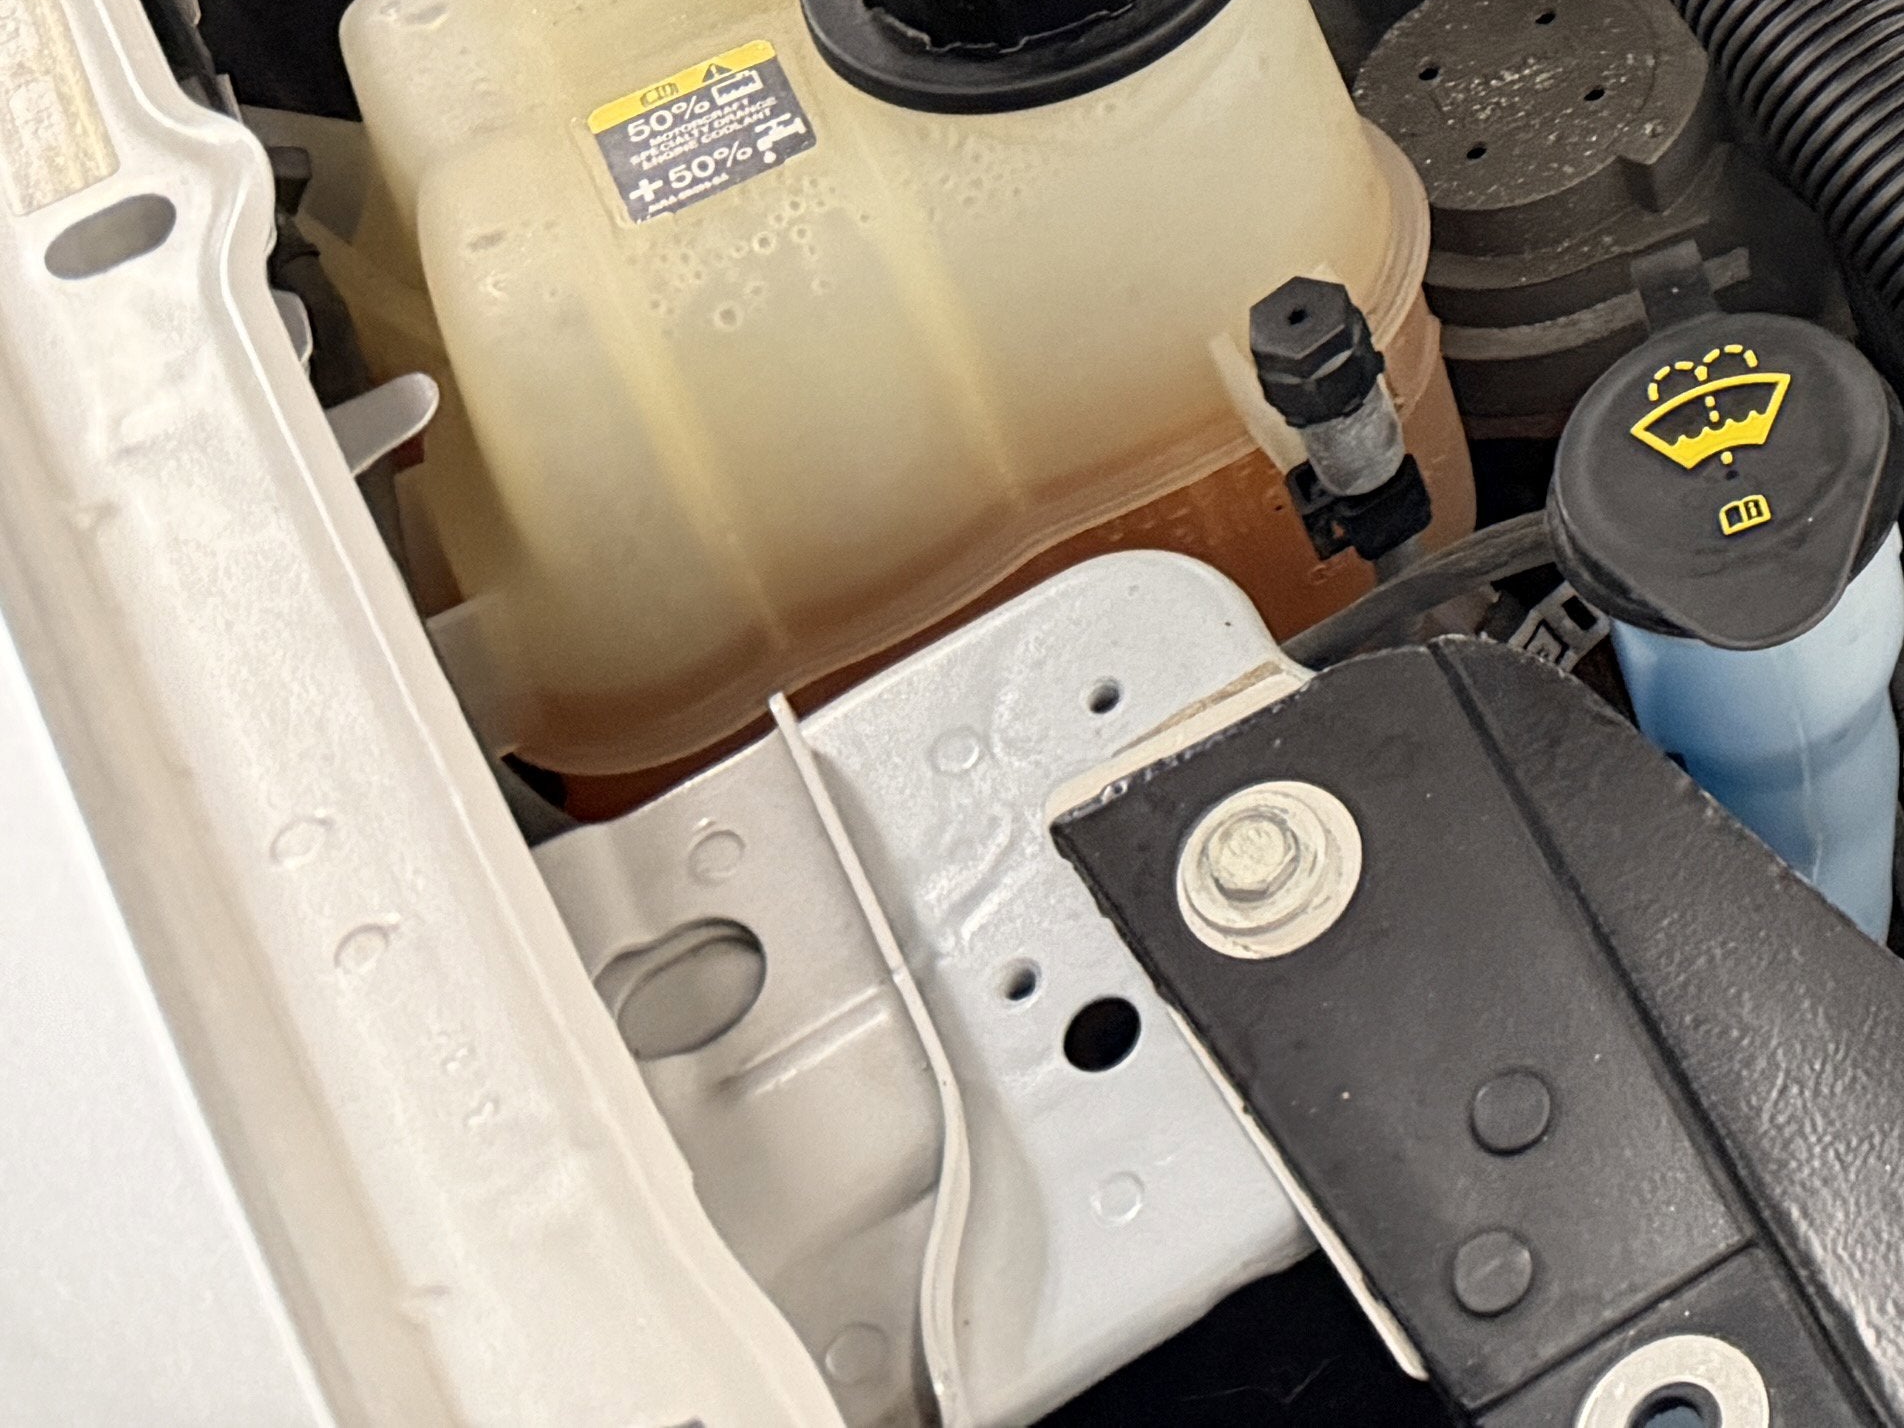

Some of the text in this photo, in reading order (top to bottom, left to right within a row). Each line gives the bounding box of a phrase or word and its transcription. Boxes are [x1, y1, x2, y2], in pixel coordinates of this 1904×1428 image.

[625, 94, 711, 144] 50%
[629, 95, 777, 166] SPECIALTY ORANGE
[640, 106, 771, 171] ENGINE COOLANT
[648, 97, 750, 147] MOTORCRAFT
[667, 139, 754, 190] 50%
